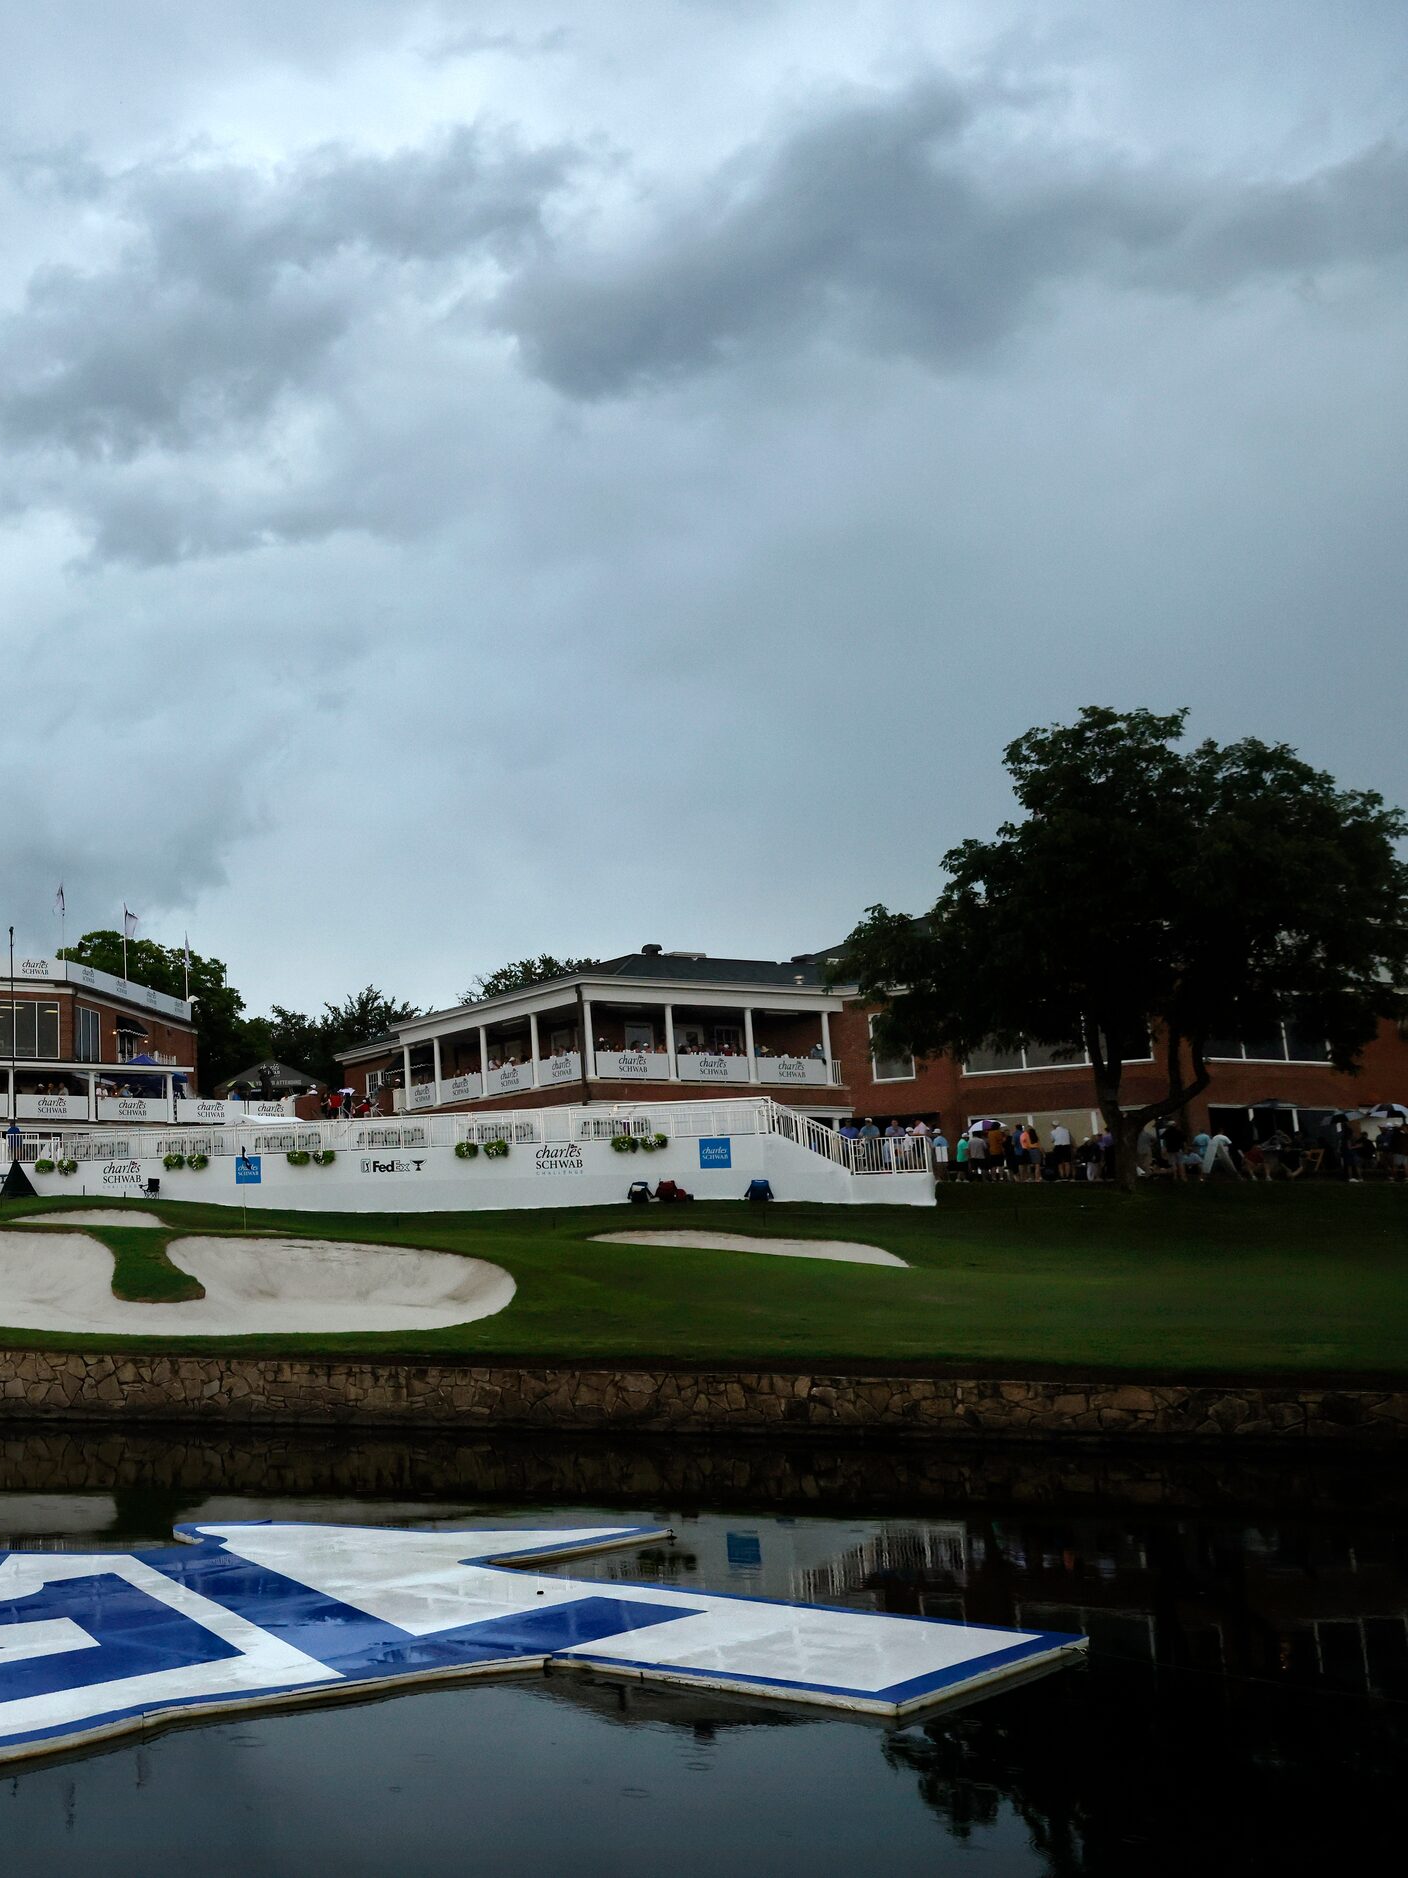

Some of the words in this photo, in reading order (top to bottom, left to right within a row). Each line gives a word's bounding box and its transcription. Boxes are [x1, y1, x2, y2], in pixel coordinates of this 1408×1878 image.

[22, 960, 48, 969] charles
[618, 1055, 646, 1065] charles
[700, 1058, 726, 1068] charles
[778, 1061, 805, 1070] charles
[38, 1097, 66, 1106] charles
[119, 1100, 146, 1109] charles
[38, 1106, 67, 1114] SCHWAB
[197, 1102, 224, 1111] charles
[258, 1104, 284, 1112] charles
[536, 1144, 582, 1158] charles
[103, 1161, 141, 1174] charles
[373, 1160, 410, 1172] FedEx
[536, 1160, 583, 1169] SCHWAB
[103, 1175, 141, 1183] SCHWAB
